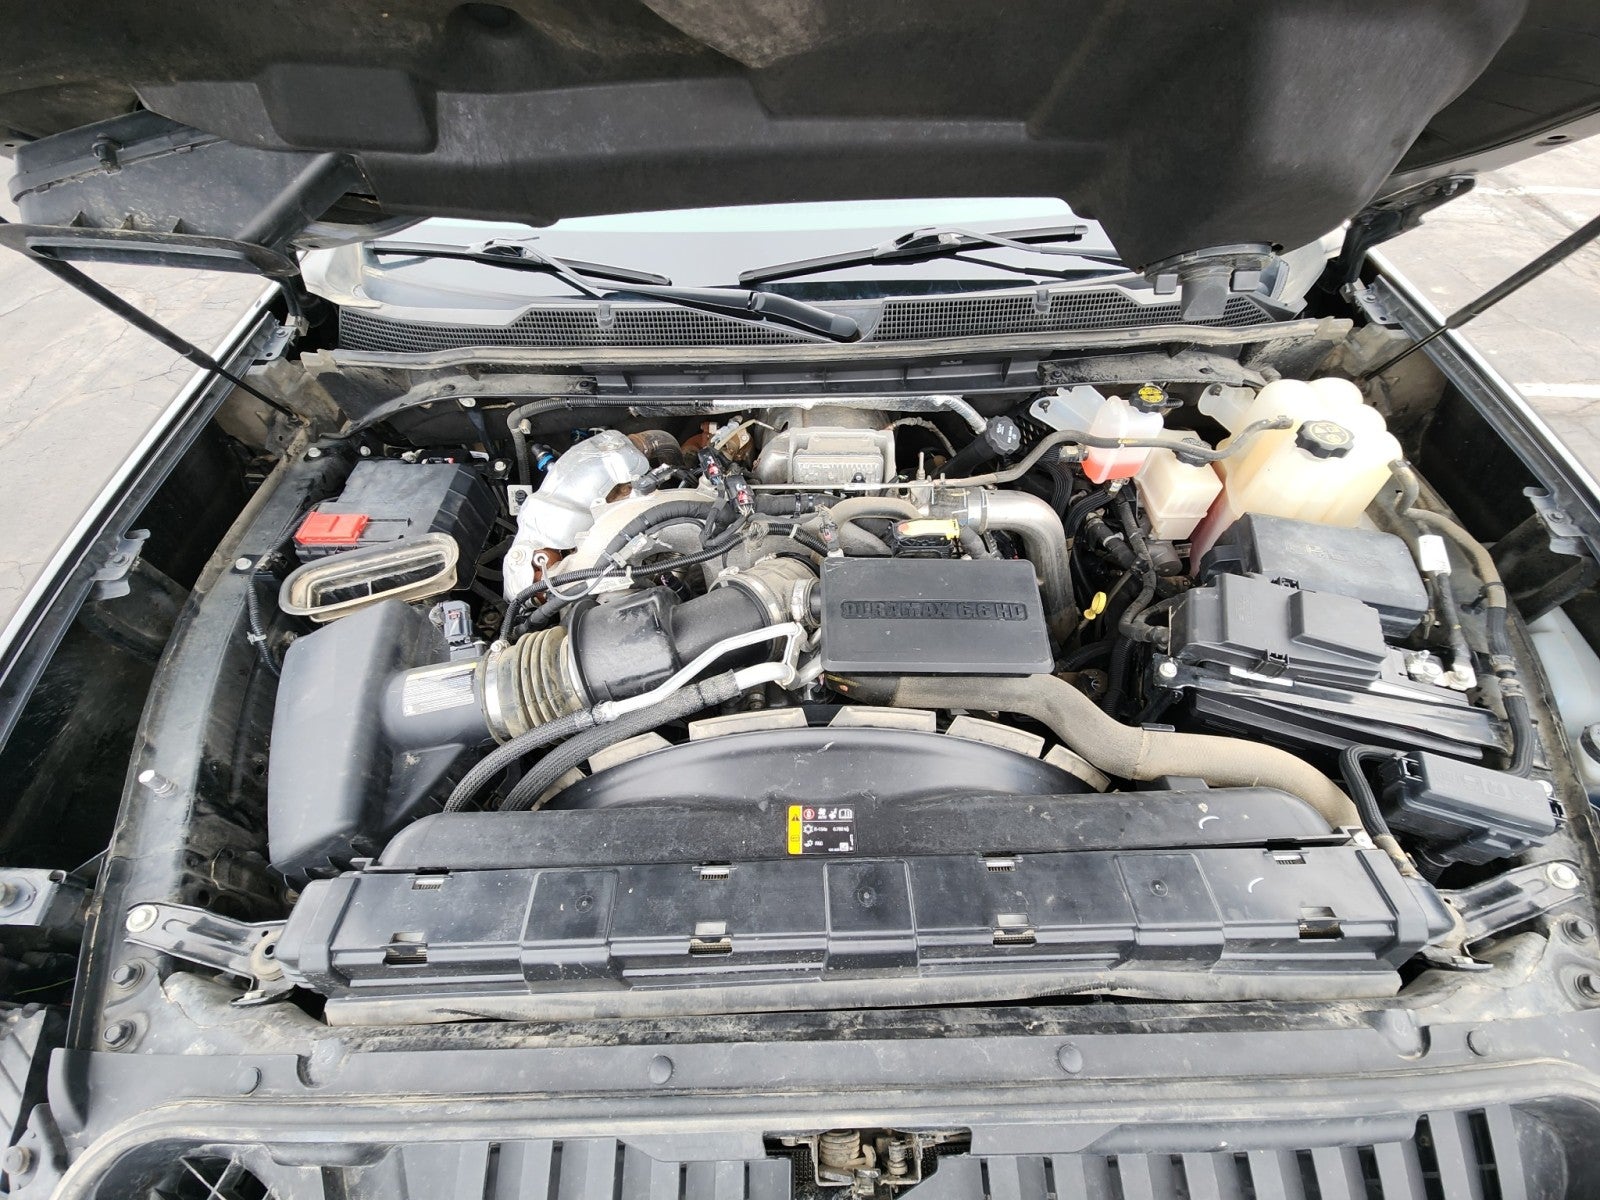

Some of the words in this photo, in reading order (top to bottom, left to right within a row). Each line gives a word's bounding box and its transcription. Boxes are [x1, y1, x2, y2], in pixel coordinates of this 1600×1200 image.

[842, 601, 949, 619] DURAMAX
[957, 602, 994, 619] 6.6
[995, 603, 1027, 620] HD
